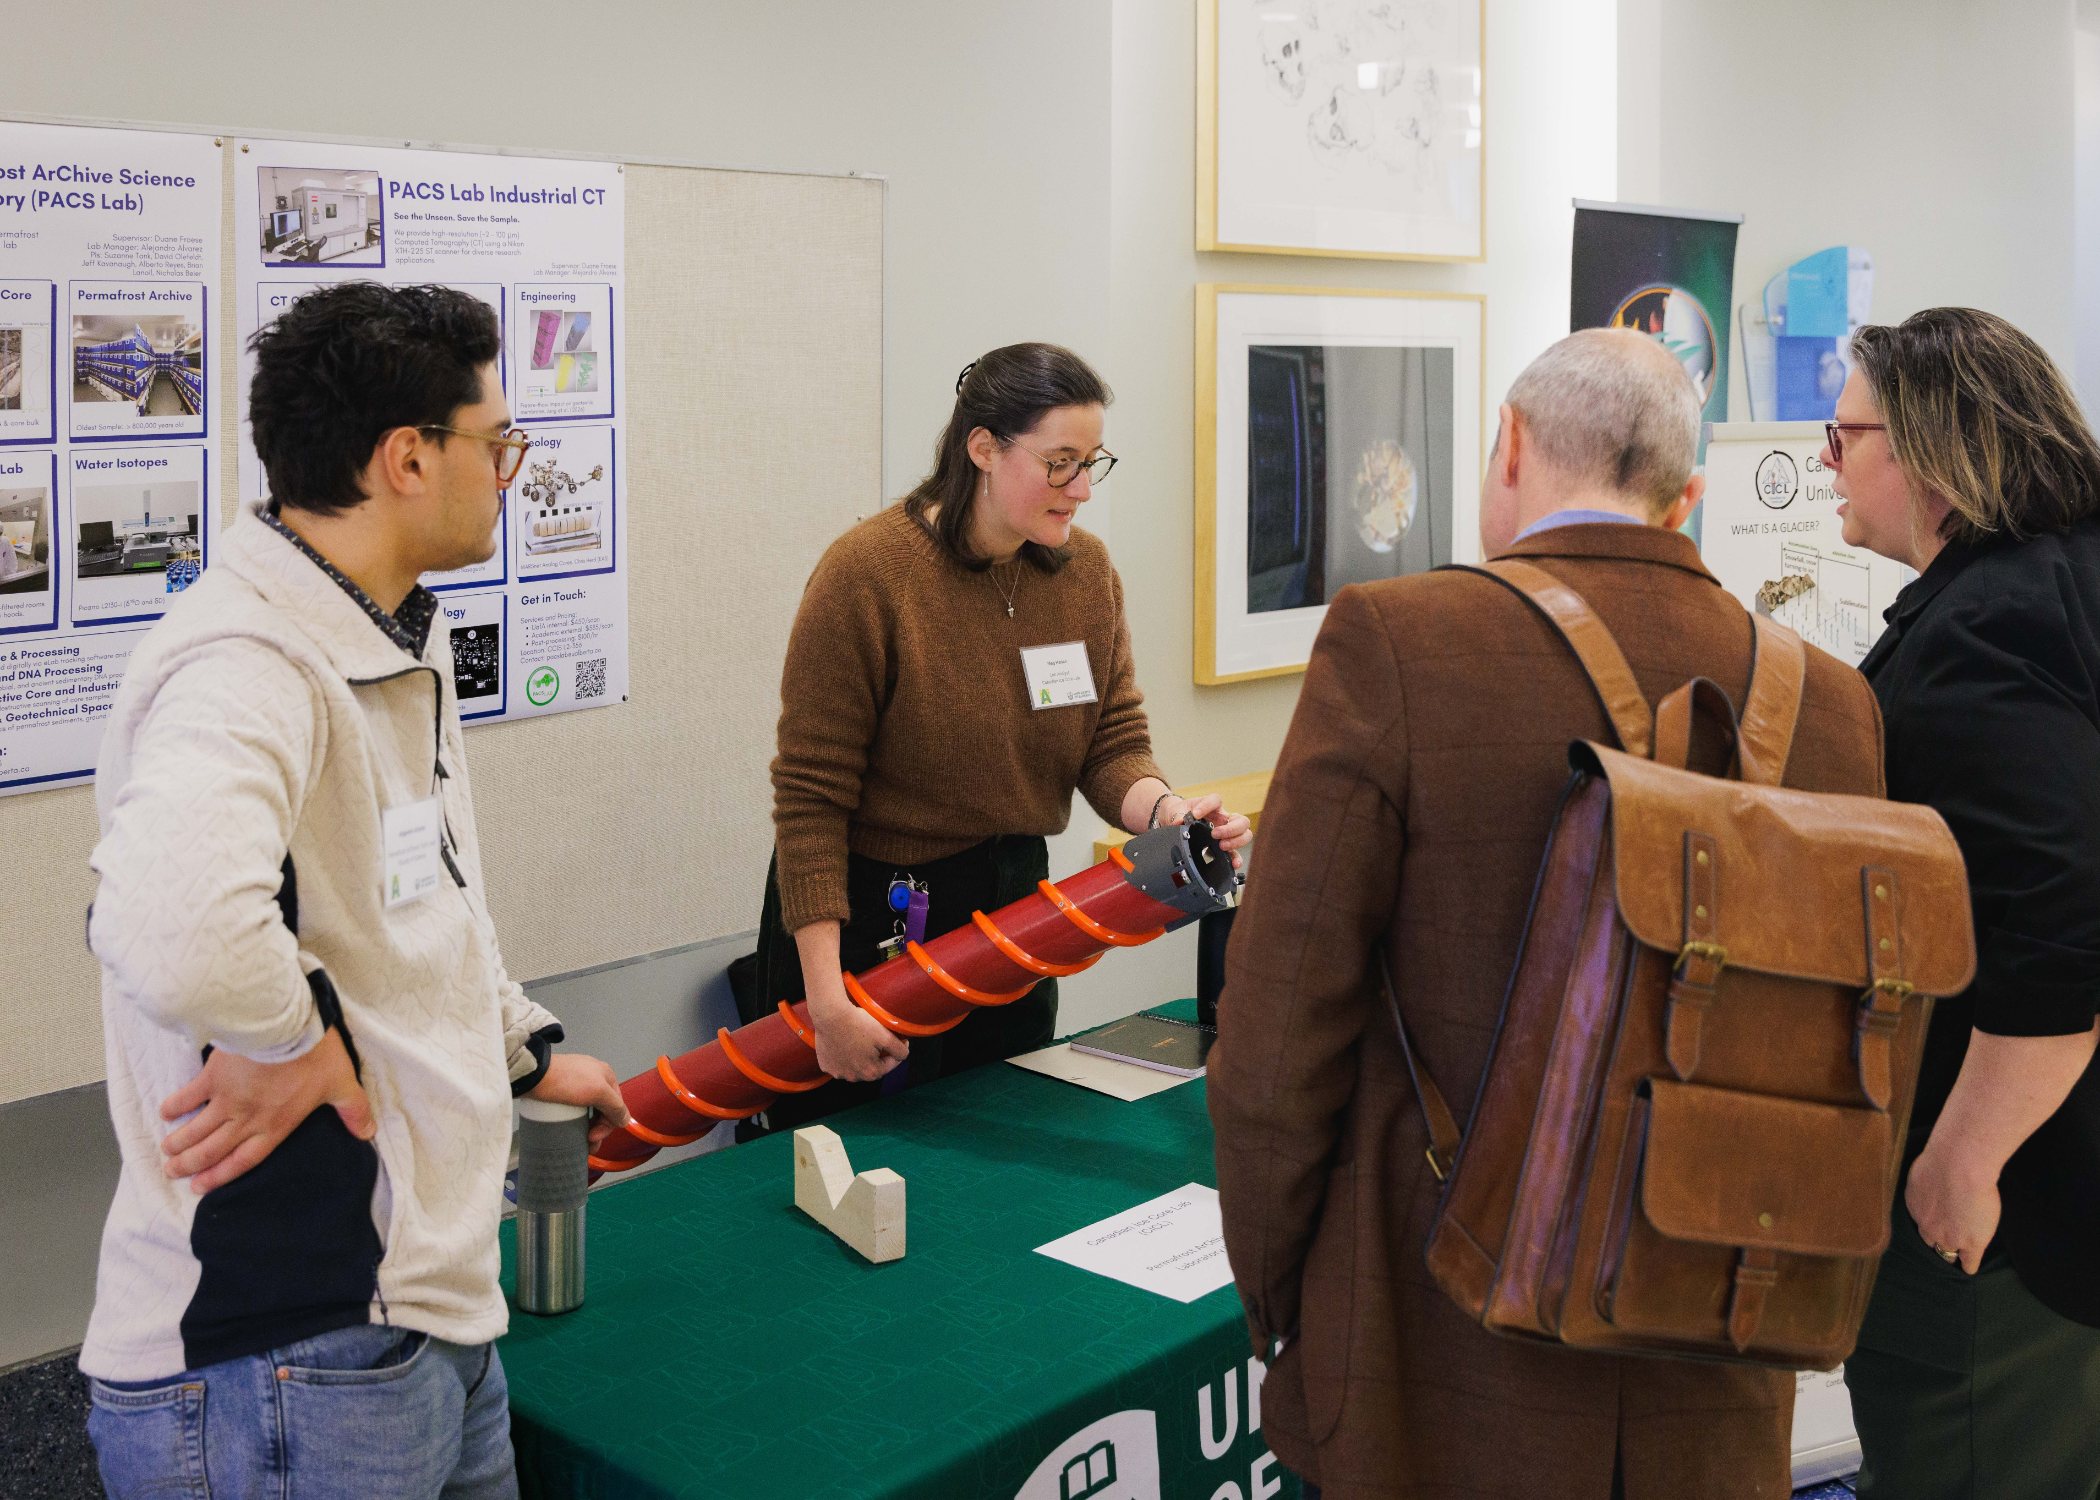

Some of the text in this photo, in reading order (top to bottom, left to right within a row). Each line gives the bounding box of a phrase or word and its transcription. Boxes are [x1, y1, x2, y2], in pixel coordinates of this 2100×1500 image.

[32, 164, 113, 184] ArChive
[119, 168, 196, 188] Science
[389, 180, 606, 205] PACS Lab Industrial CT
[32, 189, 96, 212] (PACS
[101, 193, 144, 216] Lab)
[393, 212, 520, 225] See the Unseen. Save the Sample.
[112, 233, 153, 244] Supervisor:
[154, 235, 178, 243] Duane
[406, 229, 430, 238] provide
[3, 240, 18, 248] lab
[103, 243, 139, 252] Manager:
[141, 244, 176, 253] Alejandro
[178, 245, 203, 253] Alvarez
[394, 239, 429, 248] Computed
[430, 240, 469, 249] Tomography
[81, 259, 95, 267] Jeff
[0, 289, 32, 300] Core
[78, 290, 193, 301] Permafrost Archive
[520, 292, 576, 303] Engineering
[270, 296, 288, 306] CT
[76, 424, 97, 432] Oldest
[529, 437, 561, 449] eology
[0, 463, 24, 474] Lab
[75, 458, 168, 470] Water Isotopes
[1731, 520, 1820, 535] WHAT IS A GLACIER?
[521, 588, 587, 606] Get in Touch:
[443, 607, 466, 619] logy
[10, 651, 18, 661] &
[21, 646, 80, 660] Processing
[60, 656, 86, 666] tracking
[0, 664, 103, 682] nd DNA Processing
[0, 693, 22, 703] tive
[25, 689, 52, 700] Core
[54, 685, 75, 697] and
[5, 704, 78, 722] Geotechnical
[1198, 1353, 1269, 1461] UN
[1209, 1450, 1282, 1500] F
